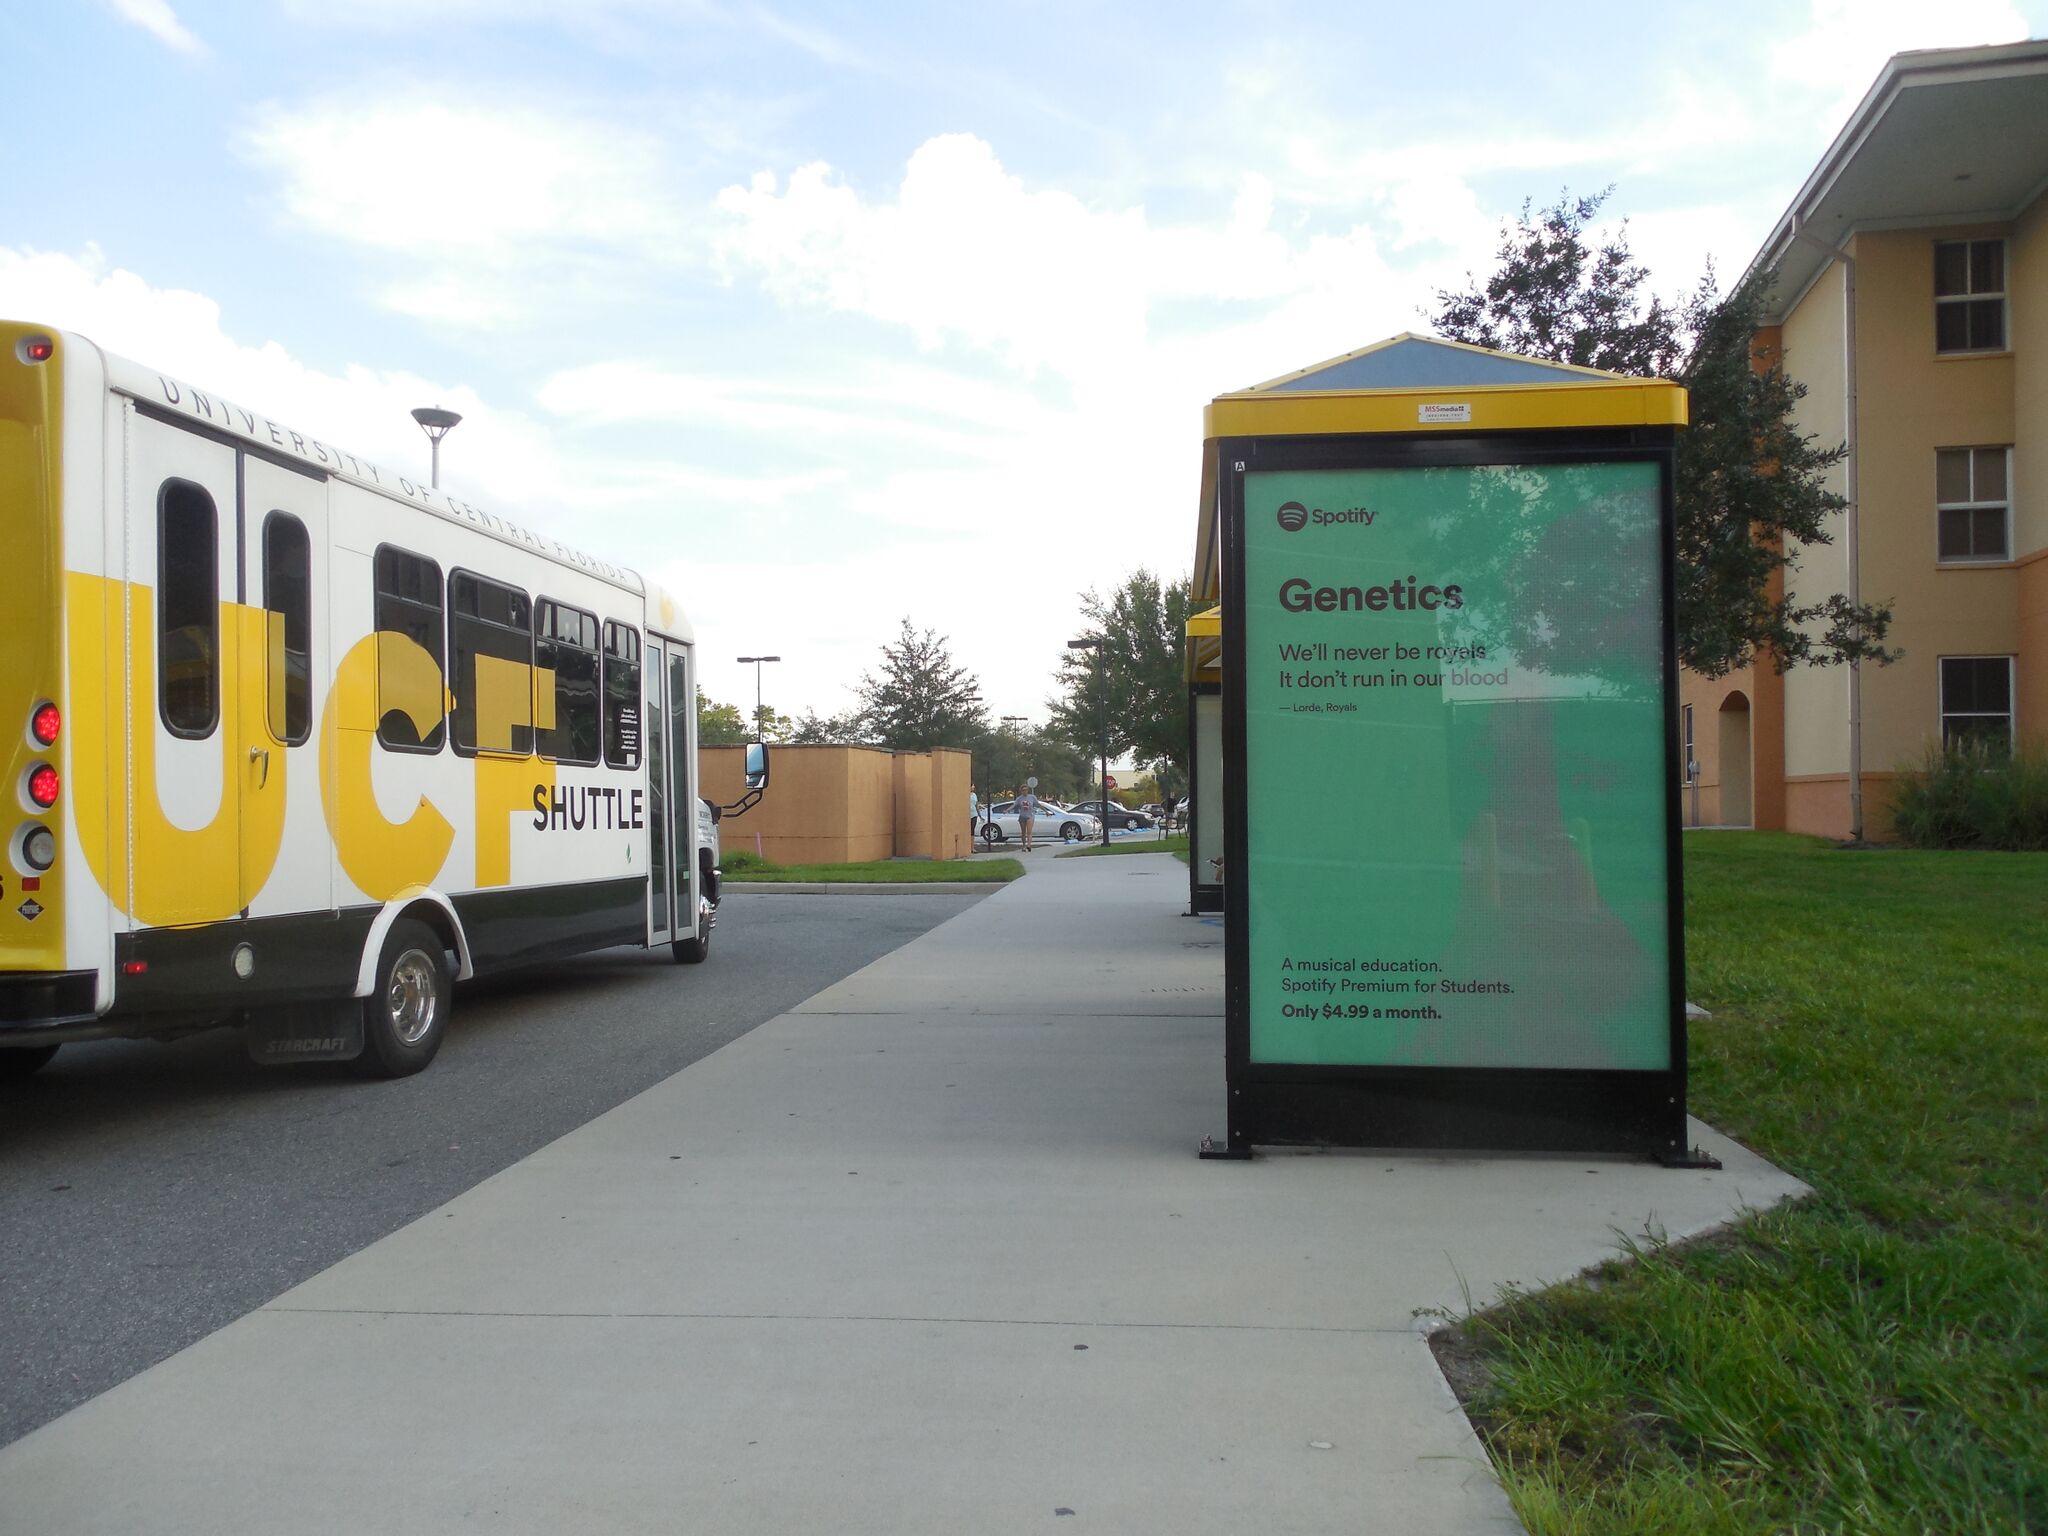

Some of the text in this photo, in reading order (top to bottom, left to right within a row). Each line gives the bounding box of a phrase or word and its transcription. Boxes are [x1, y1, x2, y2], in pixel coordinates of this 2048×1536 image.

[158, 376, 628, 582] UNIVERSITY OF CENTRAL FLORIDA
[1312, 507, 1375, 526] Spotify
[1279, 575, 1464, 613] Genetics
[1279, 643, 1328, 662] We’ll
[1334, 647, 1390, 661] never
[1395, 642, 1421, 660] be
[1280, 668, 1509, 688] It don’t run in our blood
[1293, 703, 1324, 714] Lorde,
[1326, 703, 1357, 714] Royals
[66, 571, 556, 928] UCF
[533, 784, 644, 832] SHUTTLE
[1281, 958, 1443, 973] A musical education.
[1281, 978, 1515, 995] Spotify Premium for Students.
[1281, 1003, 1442, 1021] Only $4.99 a month.
